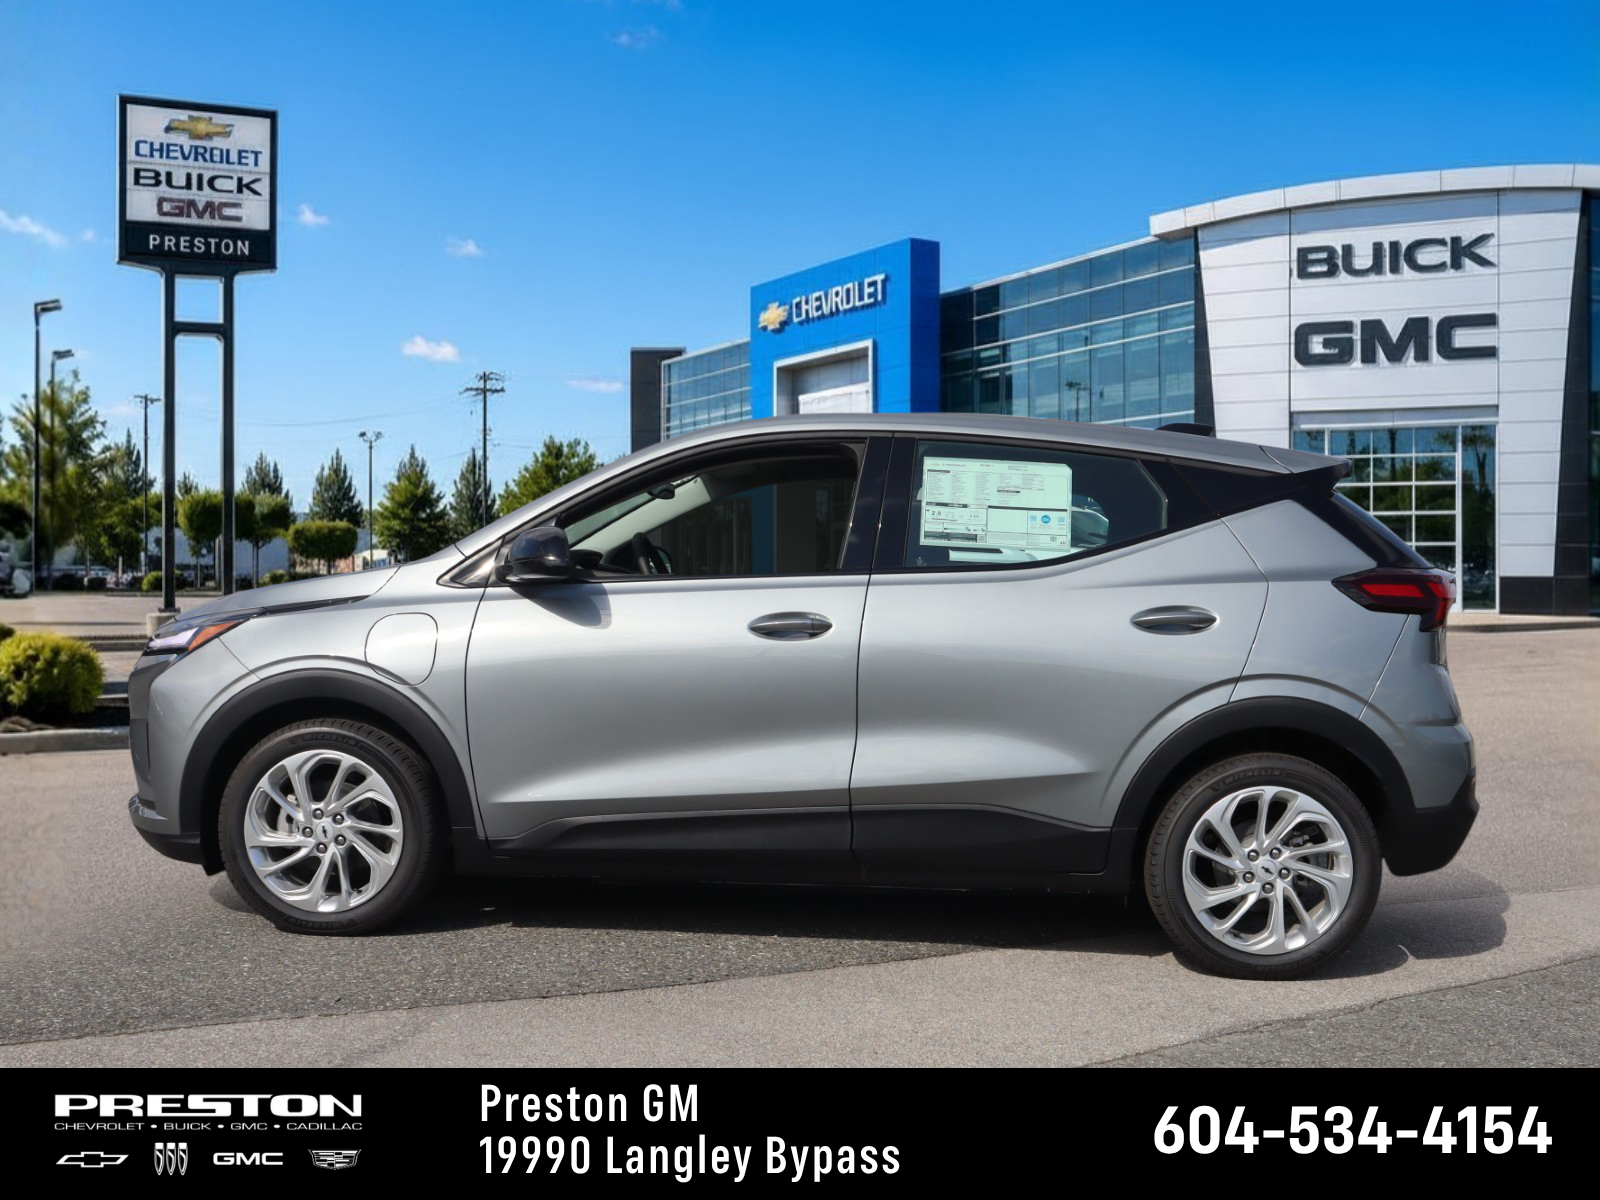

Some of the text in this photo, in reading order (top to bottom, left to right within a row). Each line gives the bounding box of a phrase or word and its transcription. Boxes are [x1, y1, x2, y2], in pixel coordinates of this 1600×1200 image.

[134, 140, 263, 167] CHEVROLET
[133, 168, 262, 196] BUICK
[157, 196, 243, 222] GMC
[149, 234, 250, 256] PRESTON
[1297, 233, 1496, 280] BUICK
[792, 273, 886, 323] CHEVROLET
[1294, 313, 1498, 367] GMC
